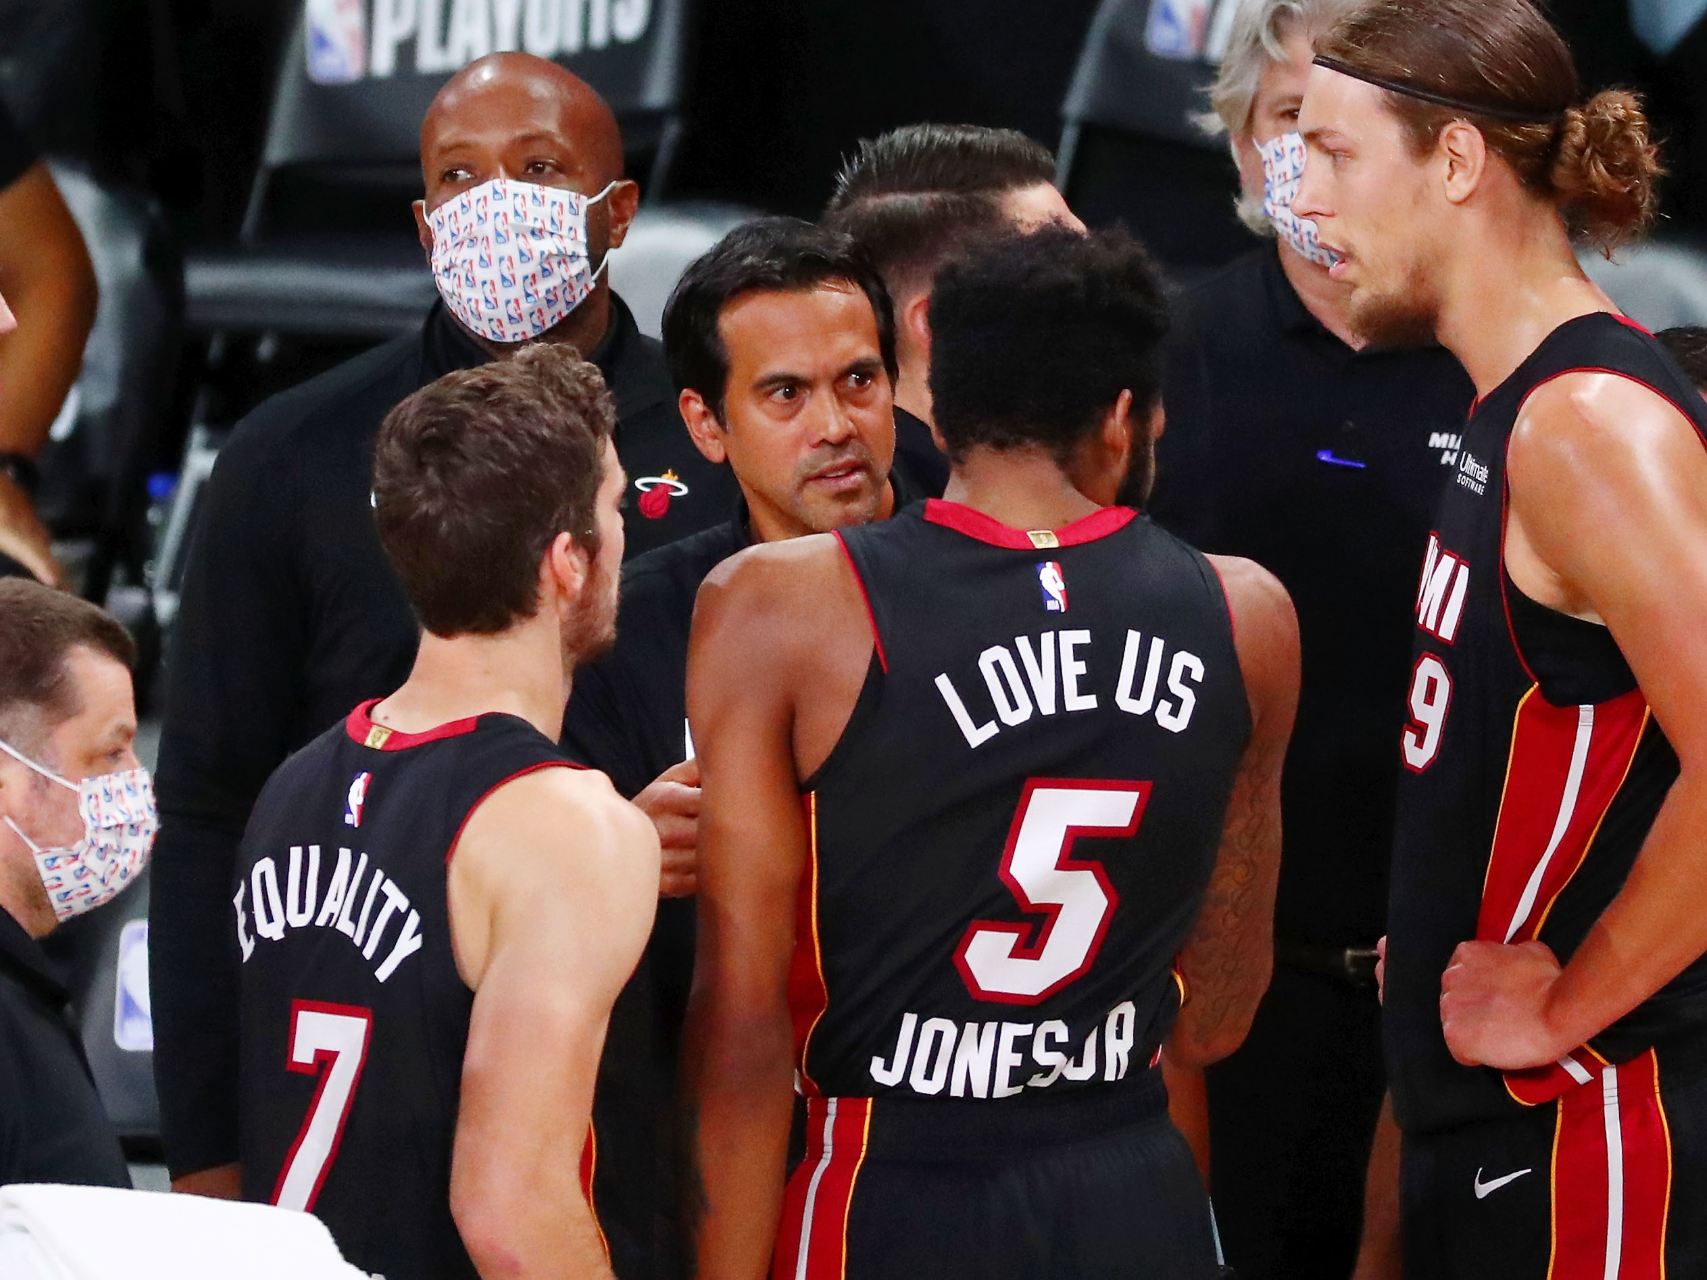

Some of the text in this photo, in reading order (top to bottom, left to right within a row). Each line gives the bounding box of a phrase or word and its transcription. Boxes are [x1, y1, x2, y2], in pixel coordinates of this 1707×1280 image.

[1456, 473, 1486, 496] SOFTWARE
[1460, 451, 1489, 484] Ultimate
[934, 629, 1205, 749] LOVE US
[1401, 651, 1453, 775] 9
[233, 845, 423, 983] EQUALITY
[952, 777, 1153, 1006] 5
[268, 999, 373, 1213] 7
[869, 1000, 1136, 1099] JONES JR
